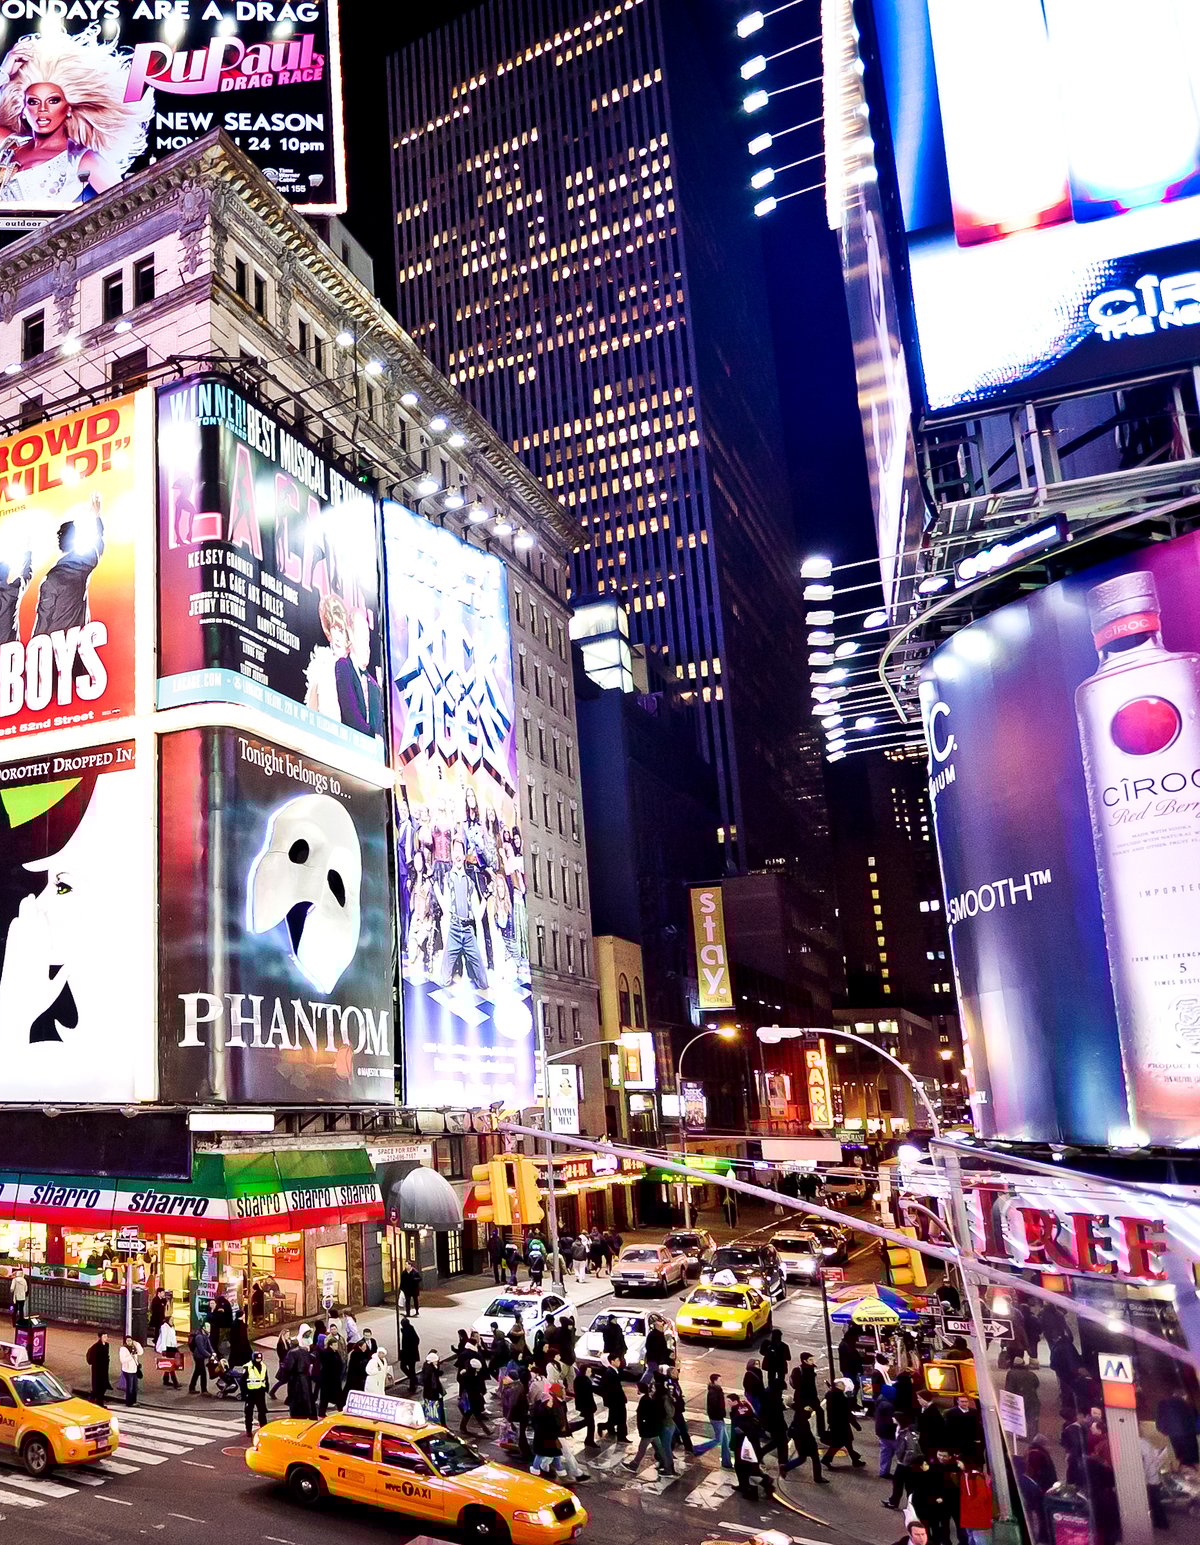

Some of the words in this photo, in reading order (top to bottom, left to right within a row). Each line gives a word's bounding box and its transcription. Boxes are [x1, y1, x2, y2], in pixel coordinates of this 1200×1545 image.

[133, 1, 190, 20] ARE
[201, 2, 223, 21] A
[237, 3, 319, 22] DRAG
[220, 75, 274, 93] DRAG
[277, 68, 323, 86] RACE
[156, 113, 213, 131] NEW
[224, 114, 324, 132] SEASON
[250, 138, 271, 150] 24
[280, 138, 324, 153] 10pm
[196, 416, 223, 427] TONY
[170, 383, 247, 430] WINNER!
[247, 404, 277, 463] BEST
[279, 433, 329, 501] MUSICAL
[188, 549, 223, 568] KELSEY
[213, 570, 226, 588] LA
[19, 722, 51, 733] 52nd
[54, 712, 95, 727] Street
[238, 737, 284, 780] Tonight
[286, 760, 328, 795] belongs
[1109, 801, 1152, 827] Red
[1180, 963, 1187, 973] 5
[177, 990, 390, 1057] PHANTOM
[806, 1050, 828, 1123] PARK
[553, 1108, 575, 1116] MAMMA
[30, 1182, 100, 1209] sbarro
[128, 1190, 209, 1217] sbarro
[291, 1187, 330, 1209] sbarro
[341, 1184, 376, 1204] sbarro
[237, 1192, 280, 1218] sbarro
[953, 1322, 971, 1332] ONE
[350, 1394, 378, 1407] PRIVATE
[379, 1400, 396, 1409] EYES
[385, 1483, 401, 1492] NYC
[402, 1481, 431, 1499] TAXI
